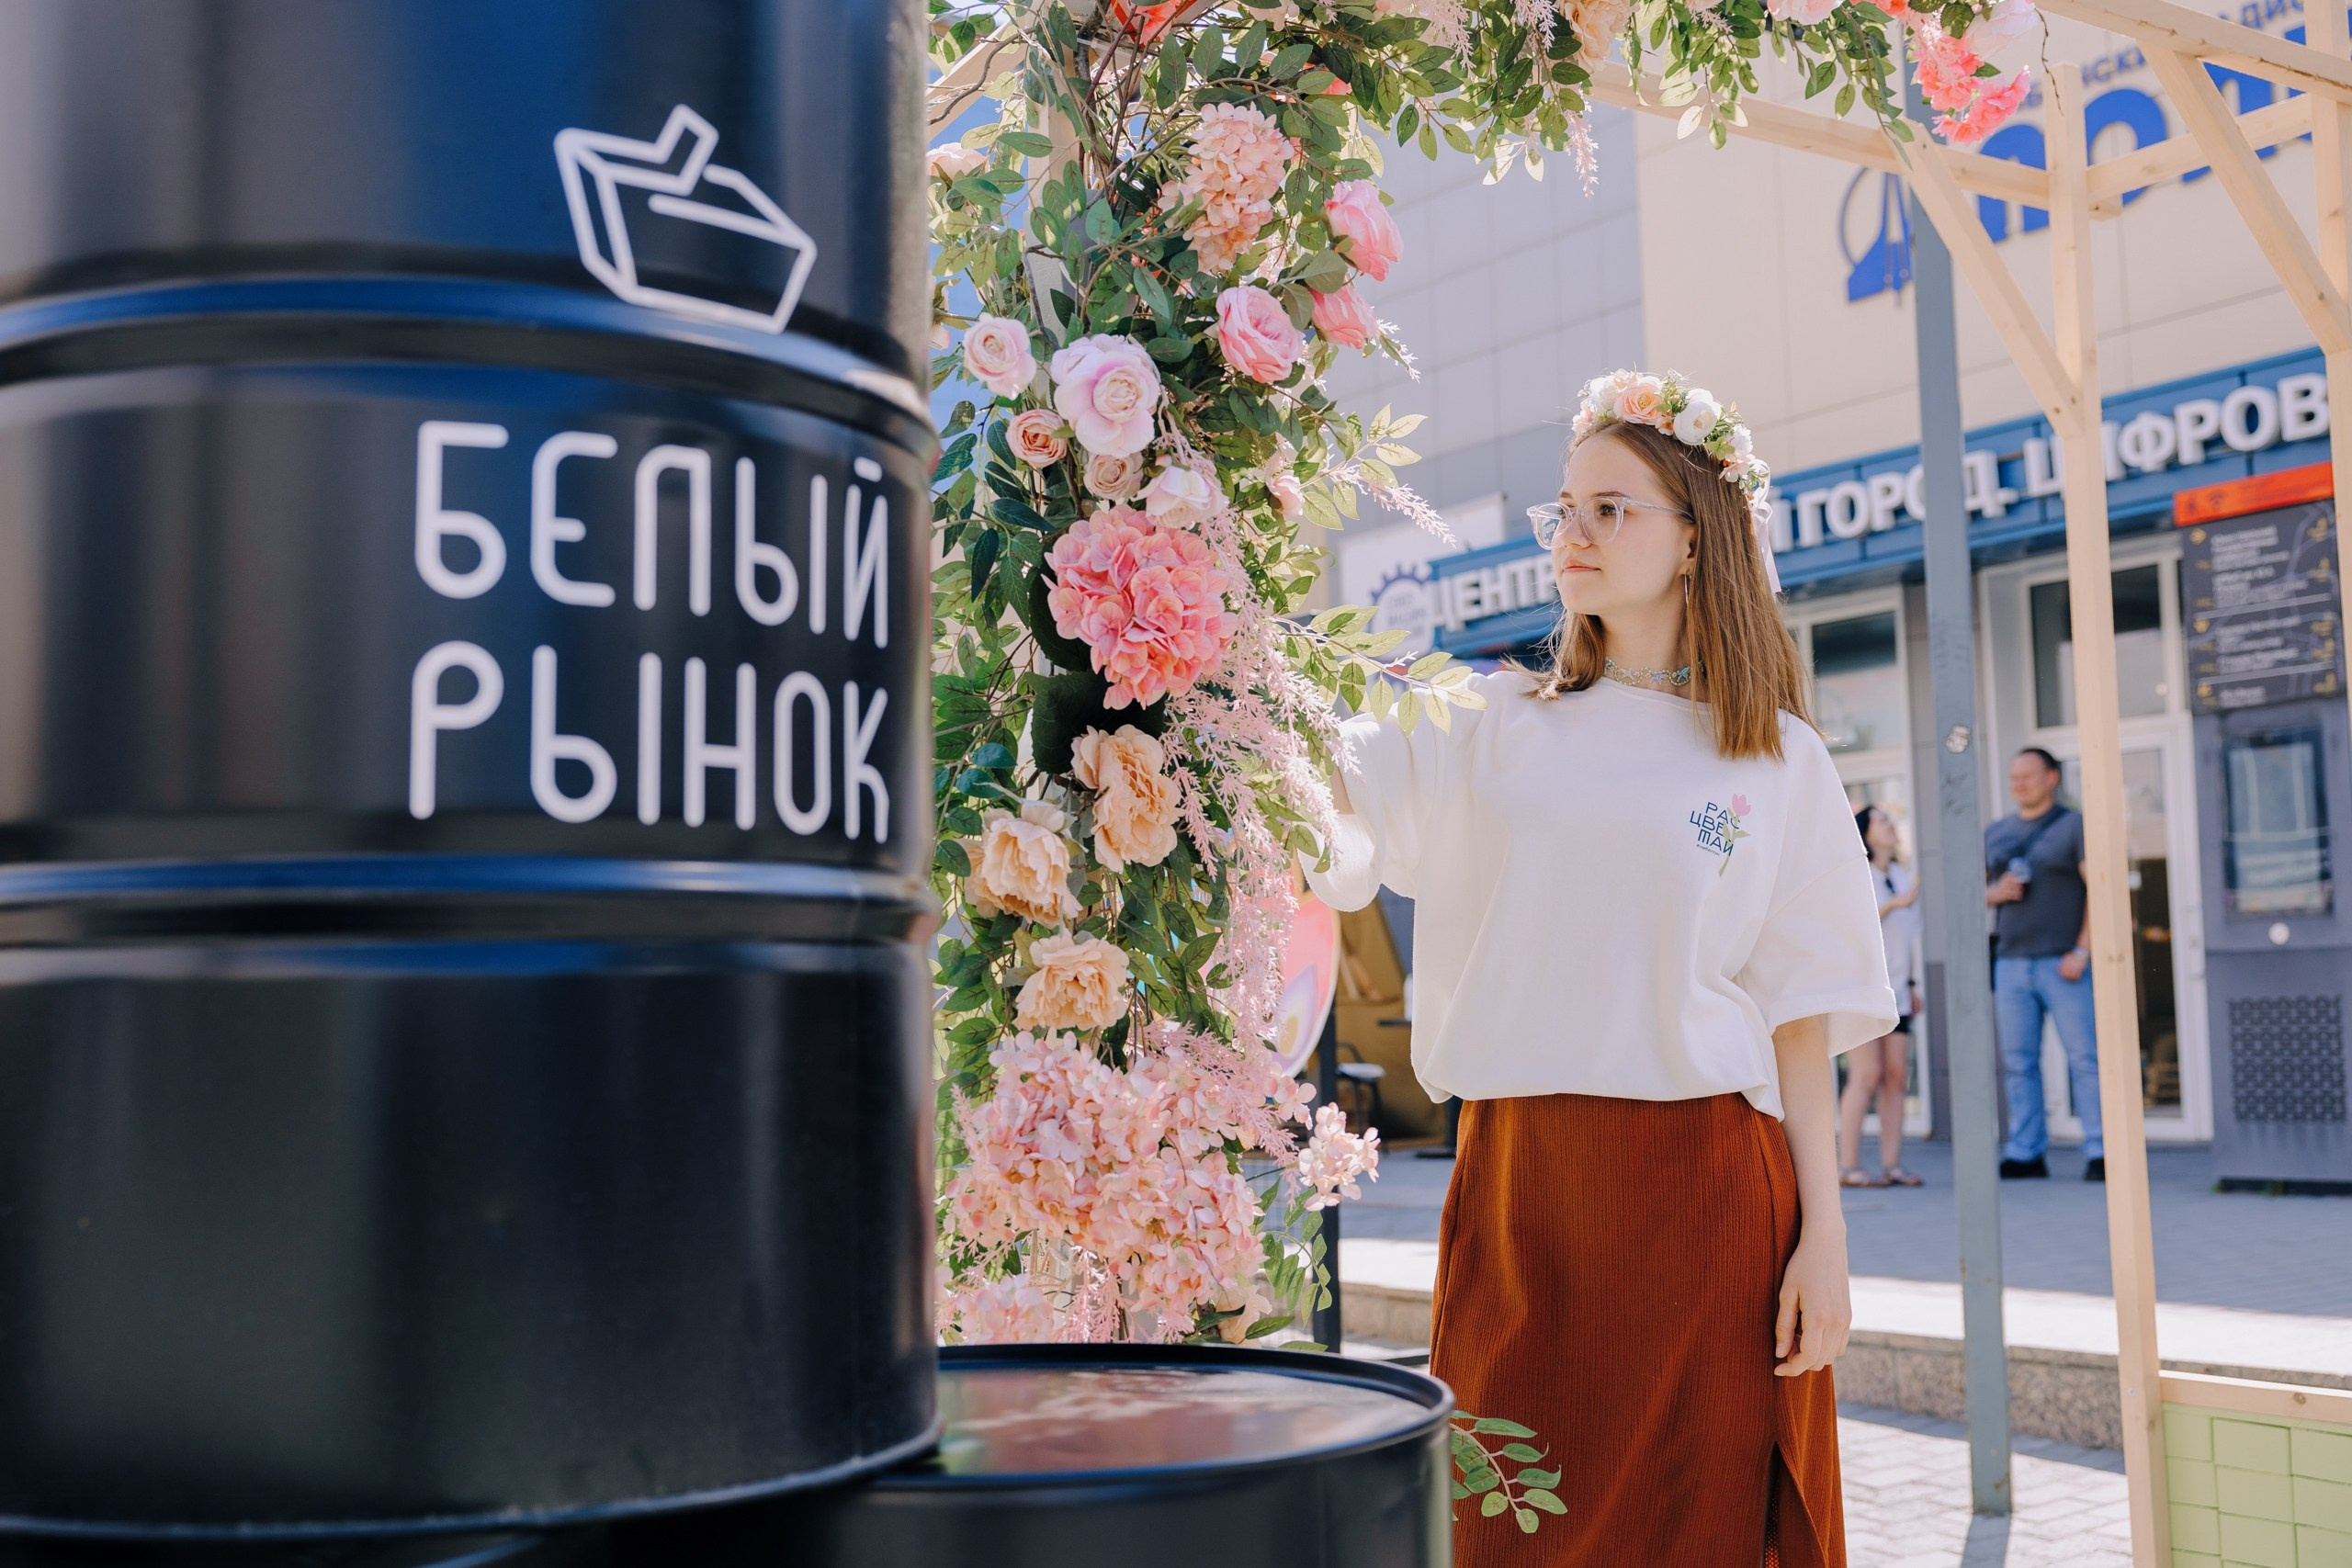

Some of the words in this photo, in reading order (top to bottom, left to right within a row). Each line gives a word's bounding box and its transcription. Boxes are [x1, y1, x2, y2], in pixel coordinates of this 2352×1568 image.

[415, 420, 888, 649] БЕЛЫЙ
[409, 640, 890, 844] РЫНОК
[1690, 810, 1724, 838] ЦВЕ
[1705, 801, 1741, 829] РАС
